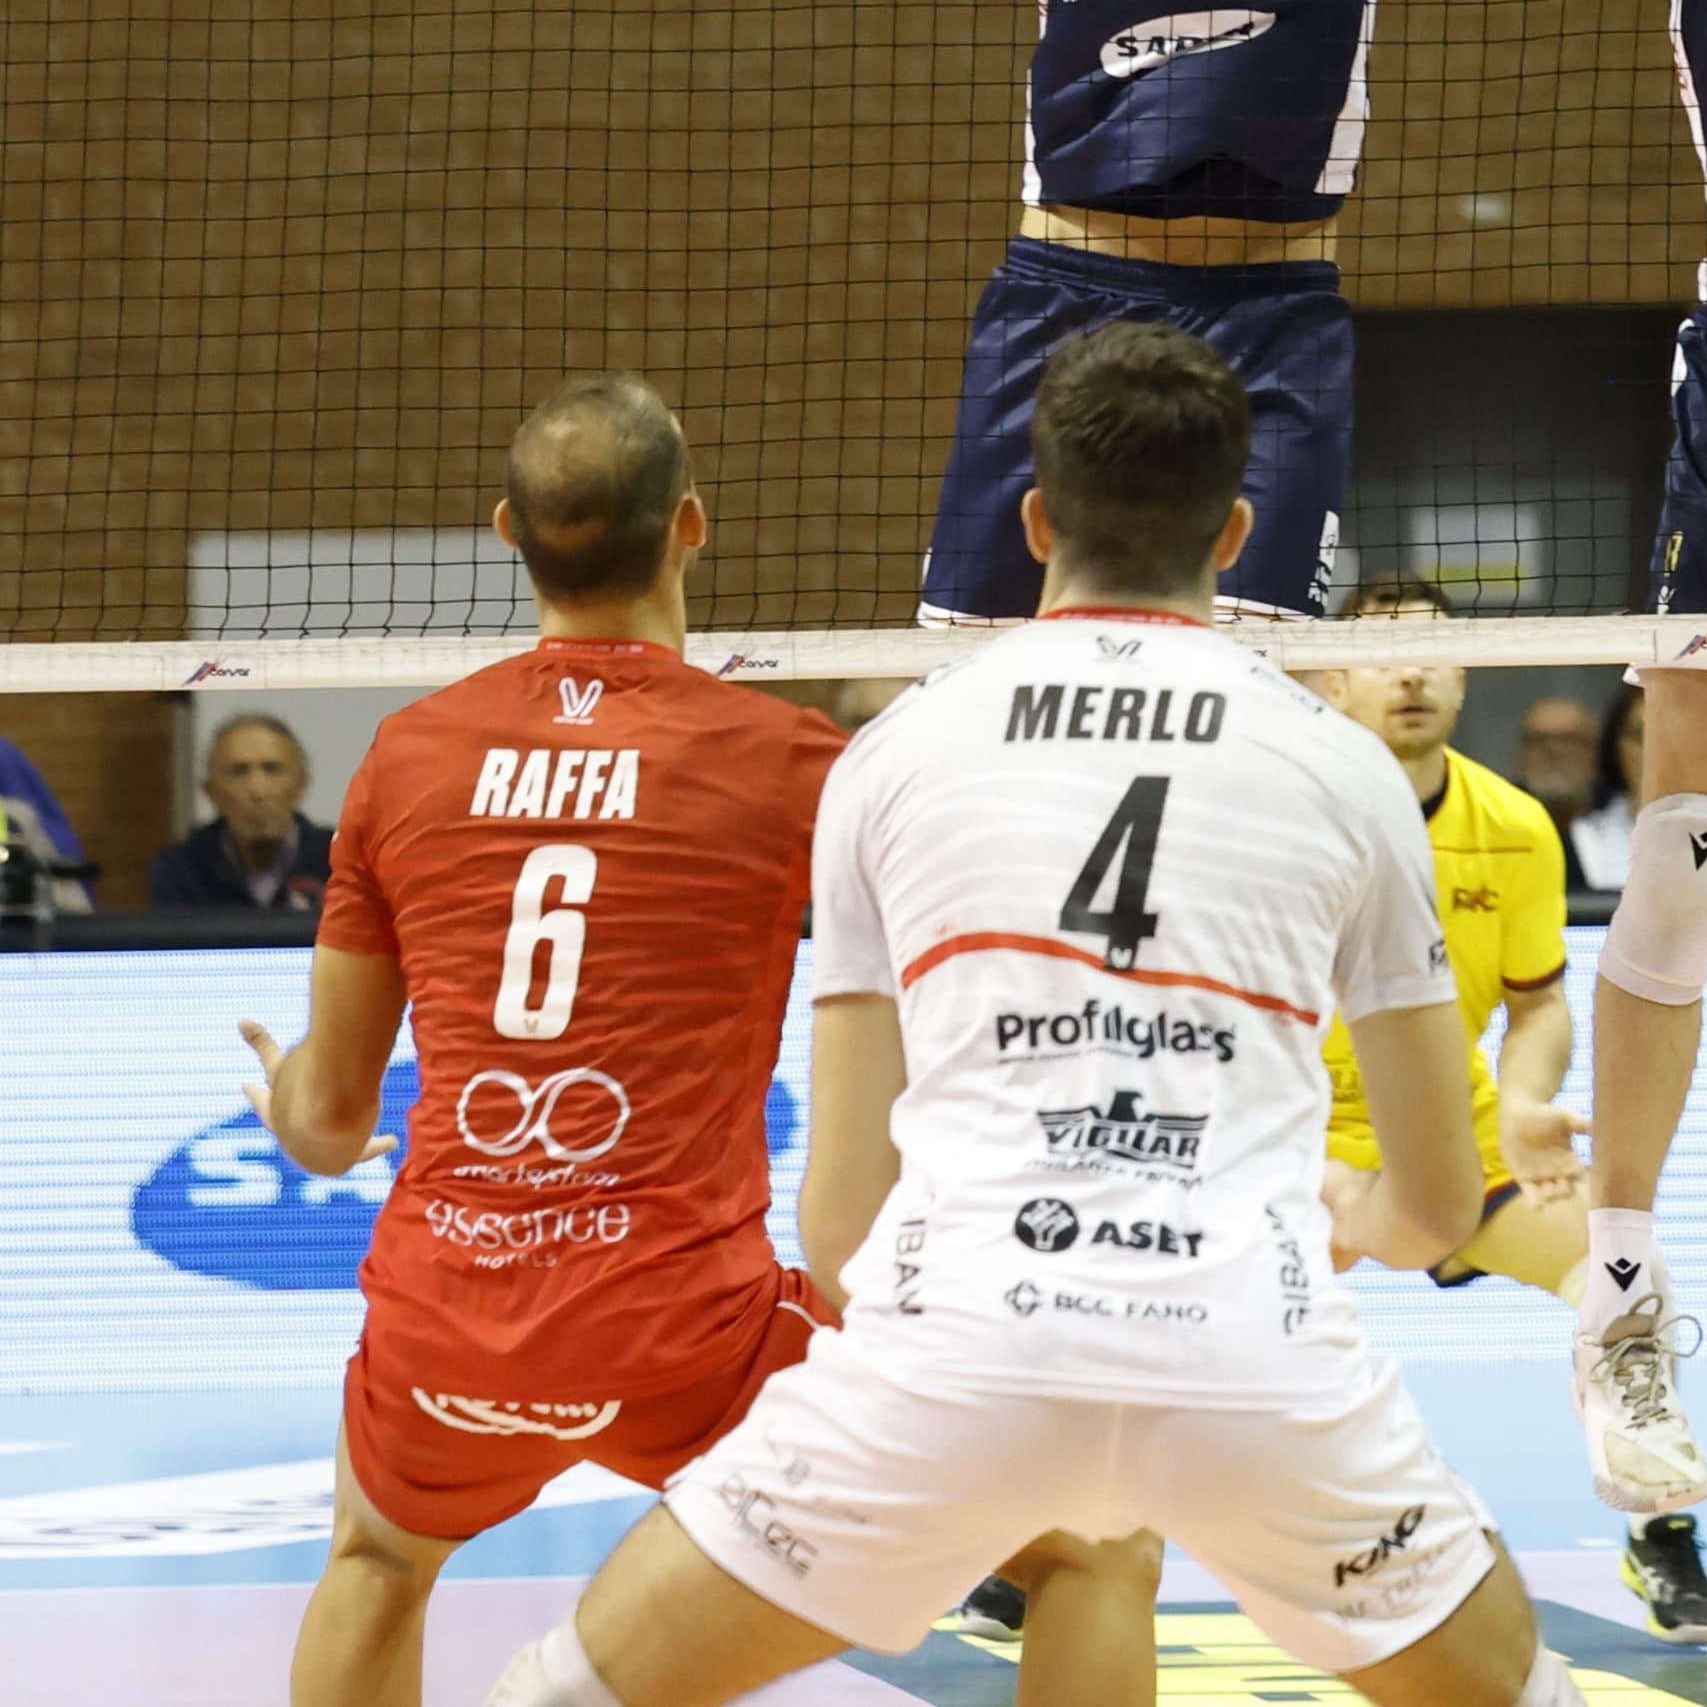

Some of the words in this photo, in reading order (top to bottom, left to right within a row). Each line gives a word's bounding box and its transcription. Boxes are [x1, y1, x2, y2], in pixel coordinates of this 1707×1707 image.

[1004, 684, 1226, 744] MERLO
[469, 748, 641, 820] RAFFA
[1057, 774, 1172, 971] 4
[493, 843, 598, 1040] 6
[1090, 1220, 1207, 1259] ASET
